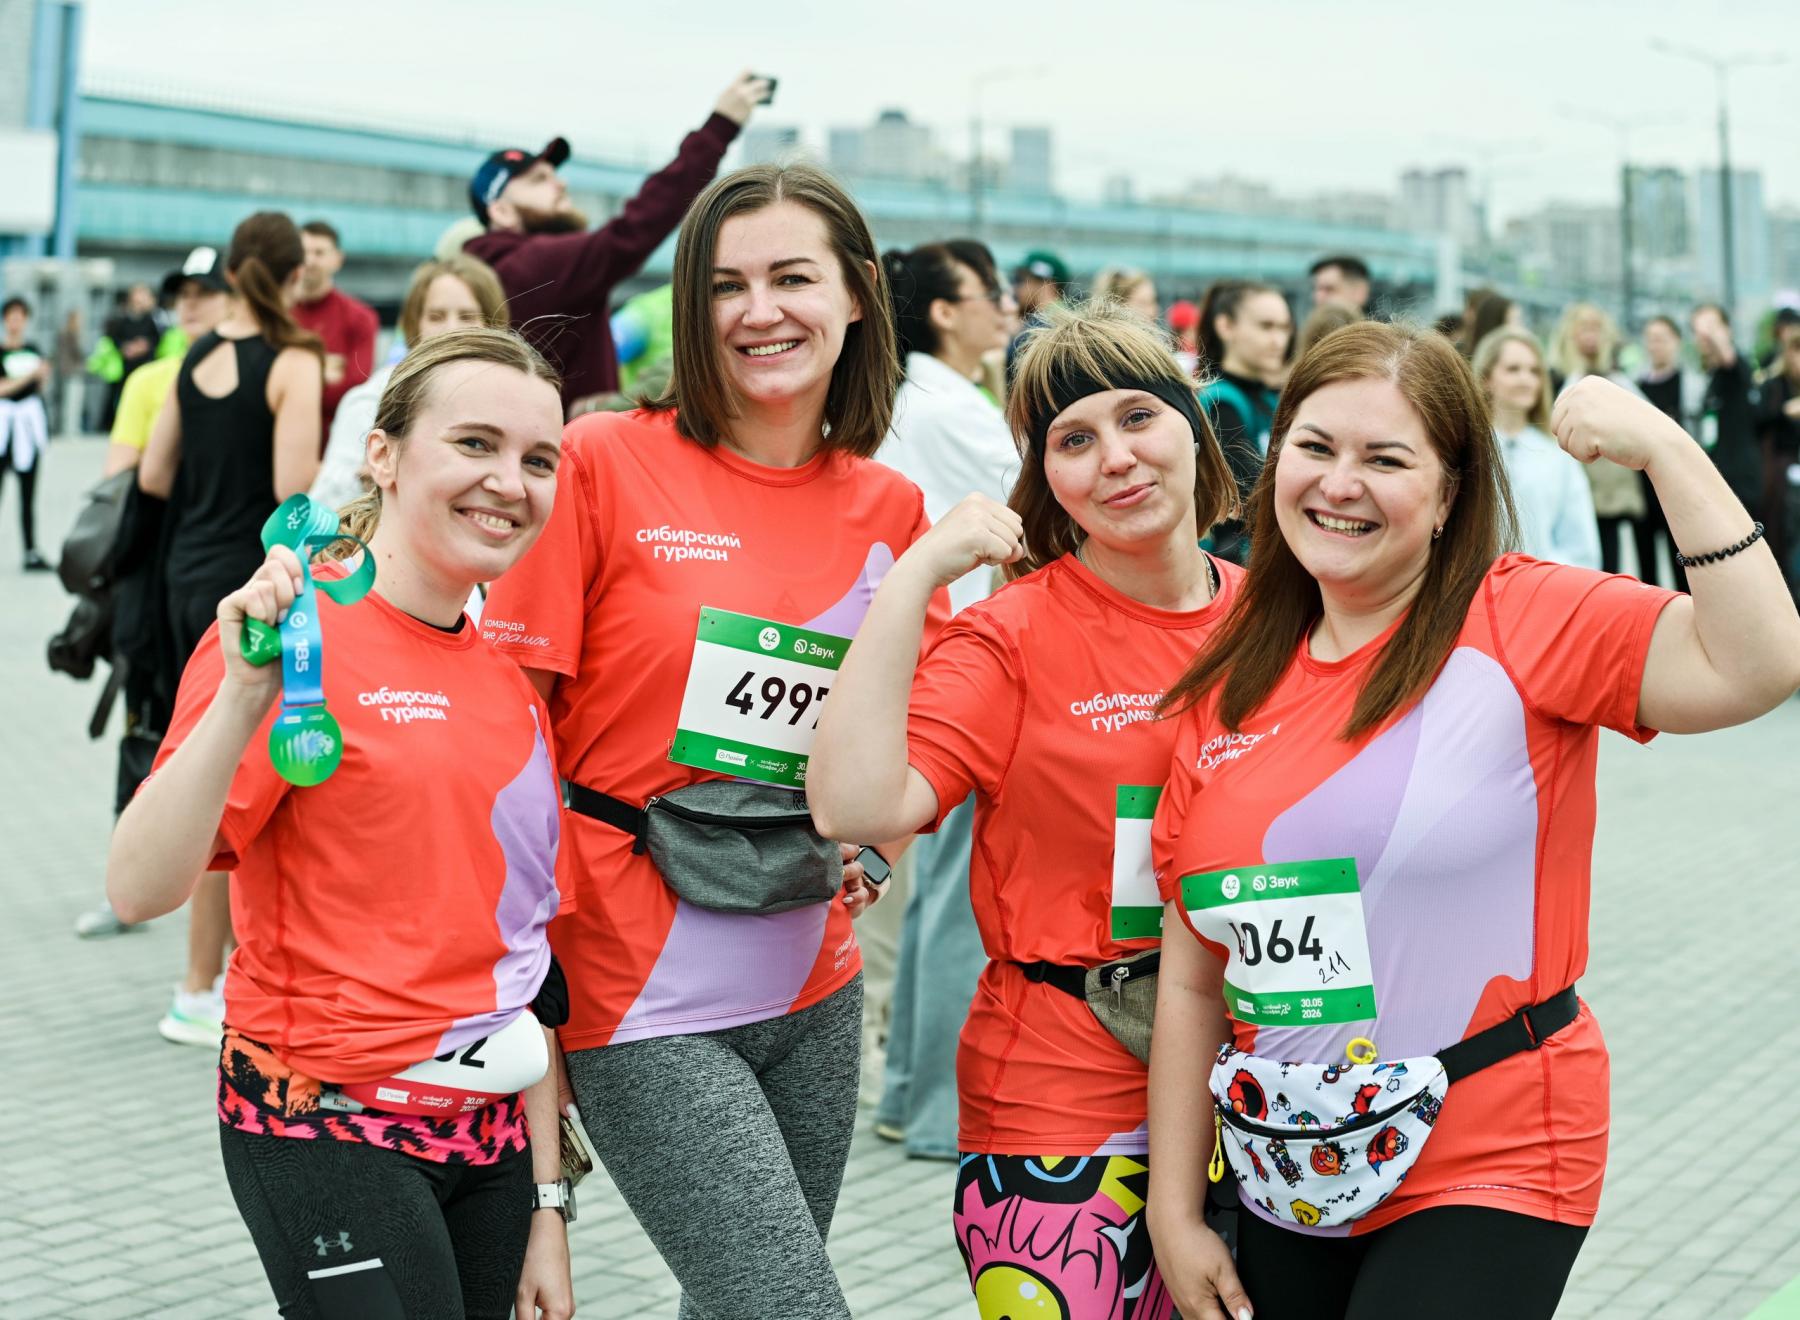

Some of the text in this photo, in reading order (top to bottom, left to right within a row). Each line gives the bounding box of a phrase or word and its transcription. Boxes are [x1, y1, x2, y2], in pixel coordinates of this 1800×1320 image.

[636, 525, 741, 549] сибирский
[654, 545, 728, 562] гурман
[809, 643, 835, 659] Звук
[358, 686, 451, 707] сибирский
[1070, 689, 1164, 716] сибирски
[380, 706, 447, 724] гурман
[1091, 710, 1163, 733] гурма
[794, 772, 806, 780] 202
[1269, 875, 1299, 889] Звук
[1228, 916, 1323, 966] 064
[1301, 997, 1323, 1008] 30.05
